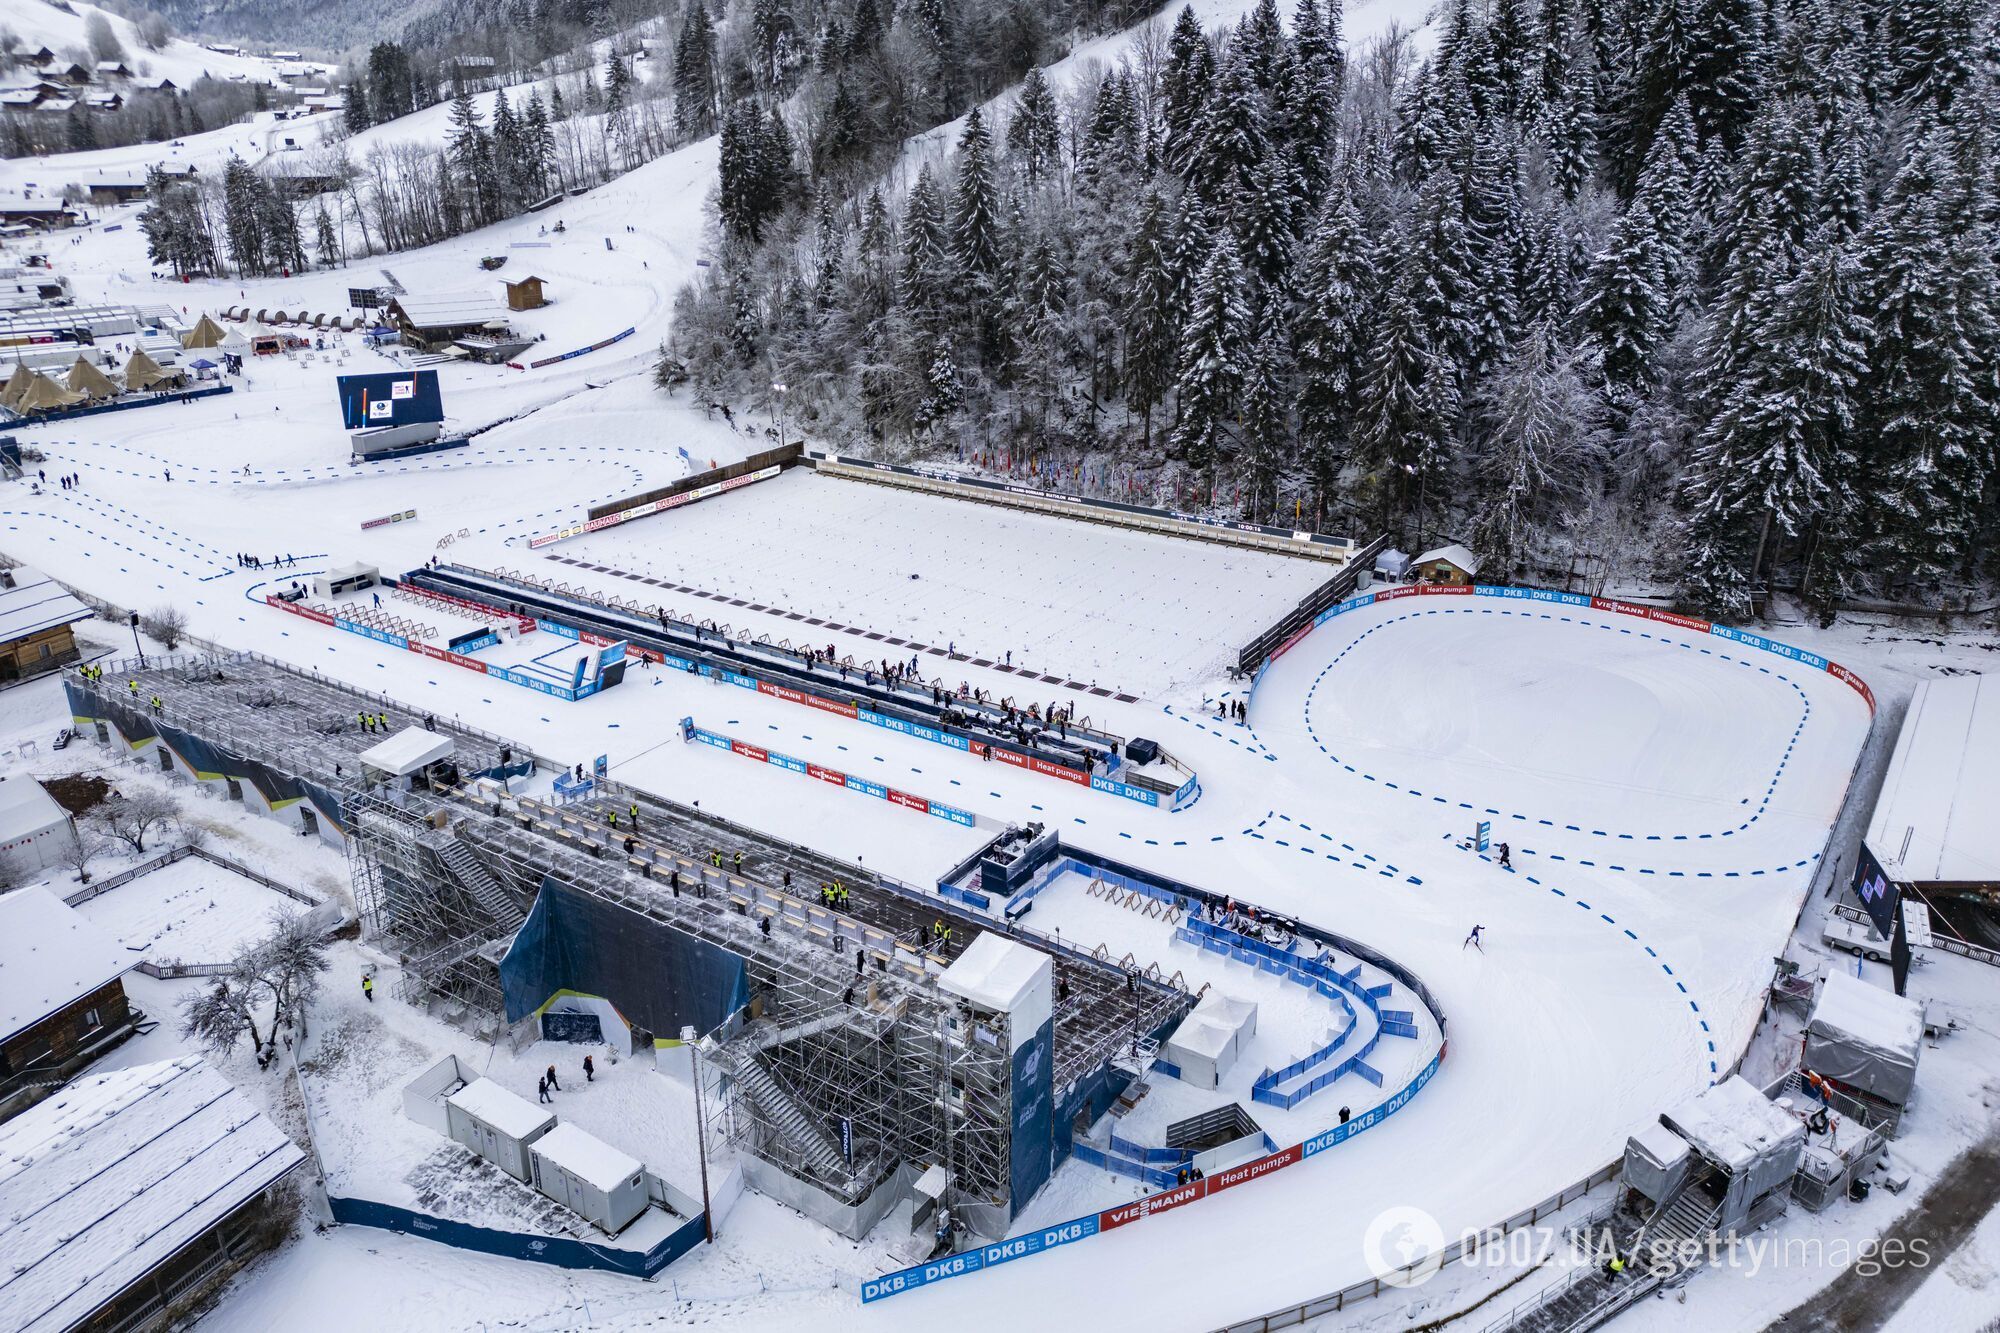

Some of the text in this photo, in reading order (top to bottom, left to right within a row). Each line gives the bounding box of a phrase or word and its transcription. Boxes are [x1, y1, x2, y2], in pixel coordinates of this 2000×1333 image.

[721, 475, 752, 490] BAUHAUS
[656, 493, 690, 510] BAUHAUS
[584, 513, 621, 531] BAUHAUS
[1378, 588, 1415, 600] VIESSMANN
[1476, 587, 1522, 597] DKB DKB
[1533, 591, 1580, 605] DKB DKB
[1355, 597, 1369, 606] DKB
[1596, 601, 1644, 615] VIESSMANN
[1652, 611, 1709, 631] Wärmepumpen
[540, 622, 553, 632] DKB
[559, 627, 573, 638] DKB
[1713, 626, 1760, 647] DKB DKB
[389, 636, 402, 646] DKB
[472, 638, 490, 651] DKB
[410, 643, 443, 658] VIESSMANN
[1771, 643, 1820, 666] DKB DKB
[451, 655, 463, 664] Heat
[666, 657, 680, 668] DKB
[488, 667, 522, 684] DKB DKB
[734, 676, 750, 687] DKB
[1832, 666, 1864, 690] VIESSMANN
[530, 680, 566, 698] DKB DKB
[577, 688, 589, 697] DKB
[761, 684, 801, 701] VIESSMANN
[808, 696, 856, 715] Wärmepumpen
[859, 711, 878, 723] DKB
[886, 719, 904, 731] DKB
[914, 726, 933, 739] DKB
[941, 735, 960, 747] DKB
[974, 745, 1023, 763] VISSMANN
[811, 770, 842, 783] VIESSMANN
[1037, 761, 1082, 782] Heat pumps
[847, 781, 880, 796] DKB DKB
[1093, 778, 1115, 793] DKB
[1125, 788, 1147, 802] DKB
[1178, 781, 1193, 798] DKB
[891, 795, 925, 809] VIESSMANN
[931, 806, 966, 824] DKB DKB
[1388, 1089, 1409, 1114] DKB
[1417, 1064, 1434, 1089] DKB
[1306, 1133, 1335, 1156] DKB
[1348, 1113, 1375, 1136] DKB
[1221, 1153, 1291, 1186] Heat pumps
[1111, 1188, 1196, 1222] VIESSMANN
[989, 1225, 1082, 1262] DKB DKB
[865, 1259, 965, 1299] DKB DKB
